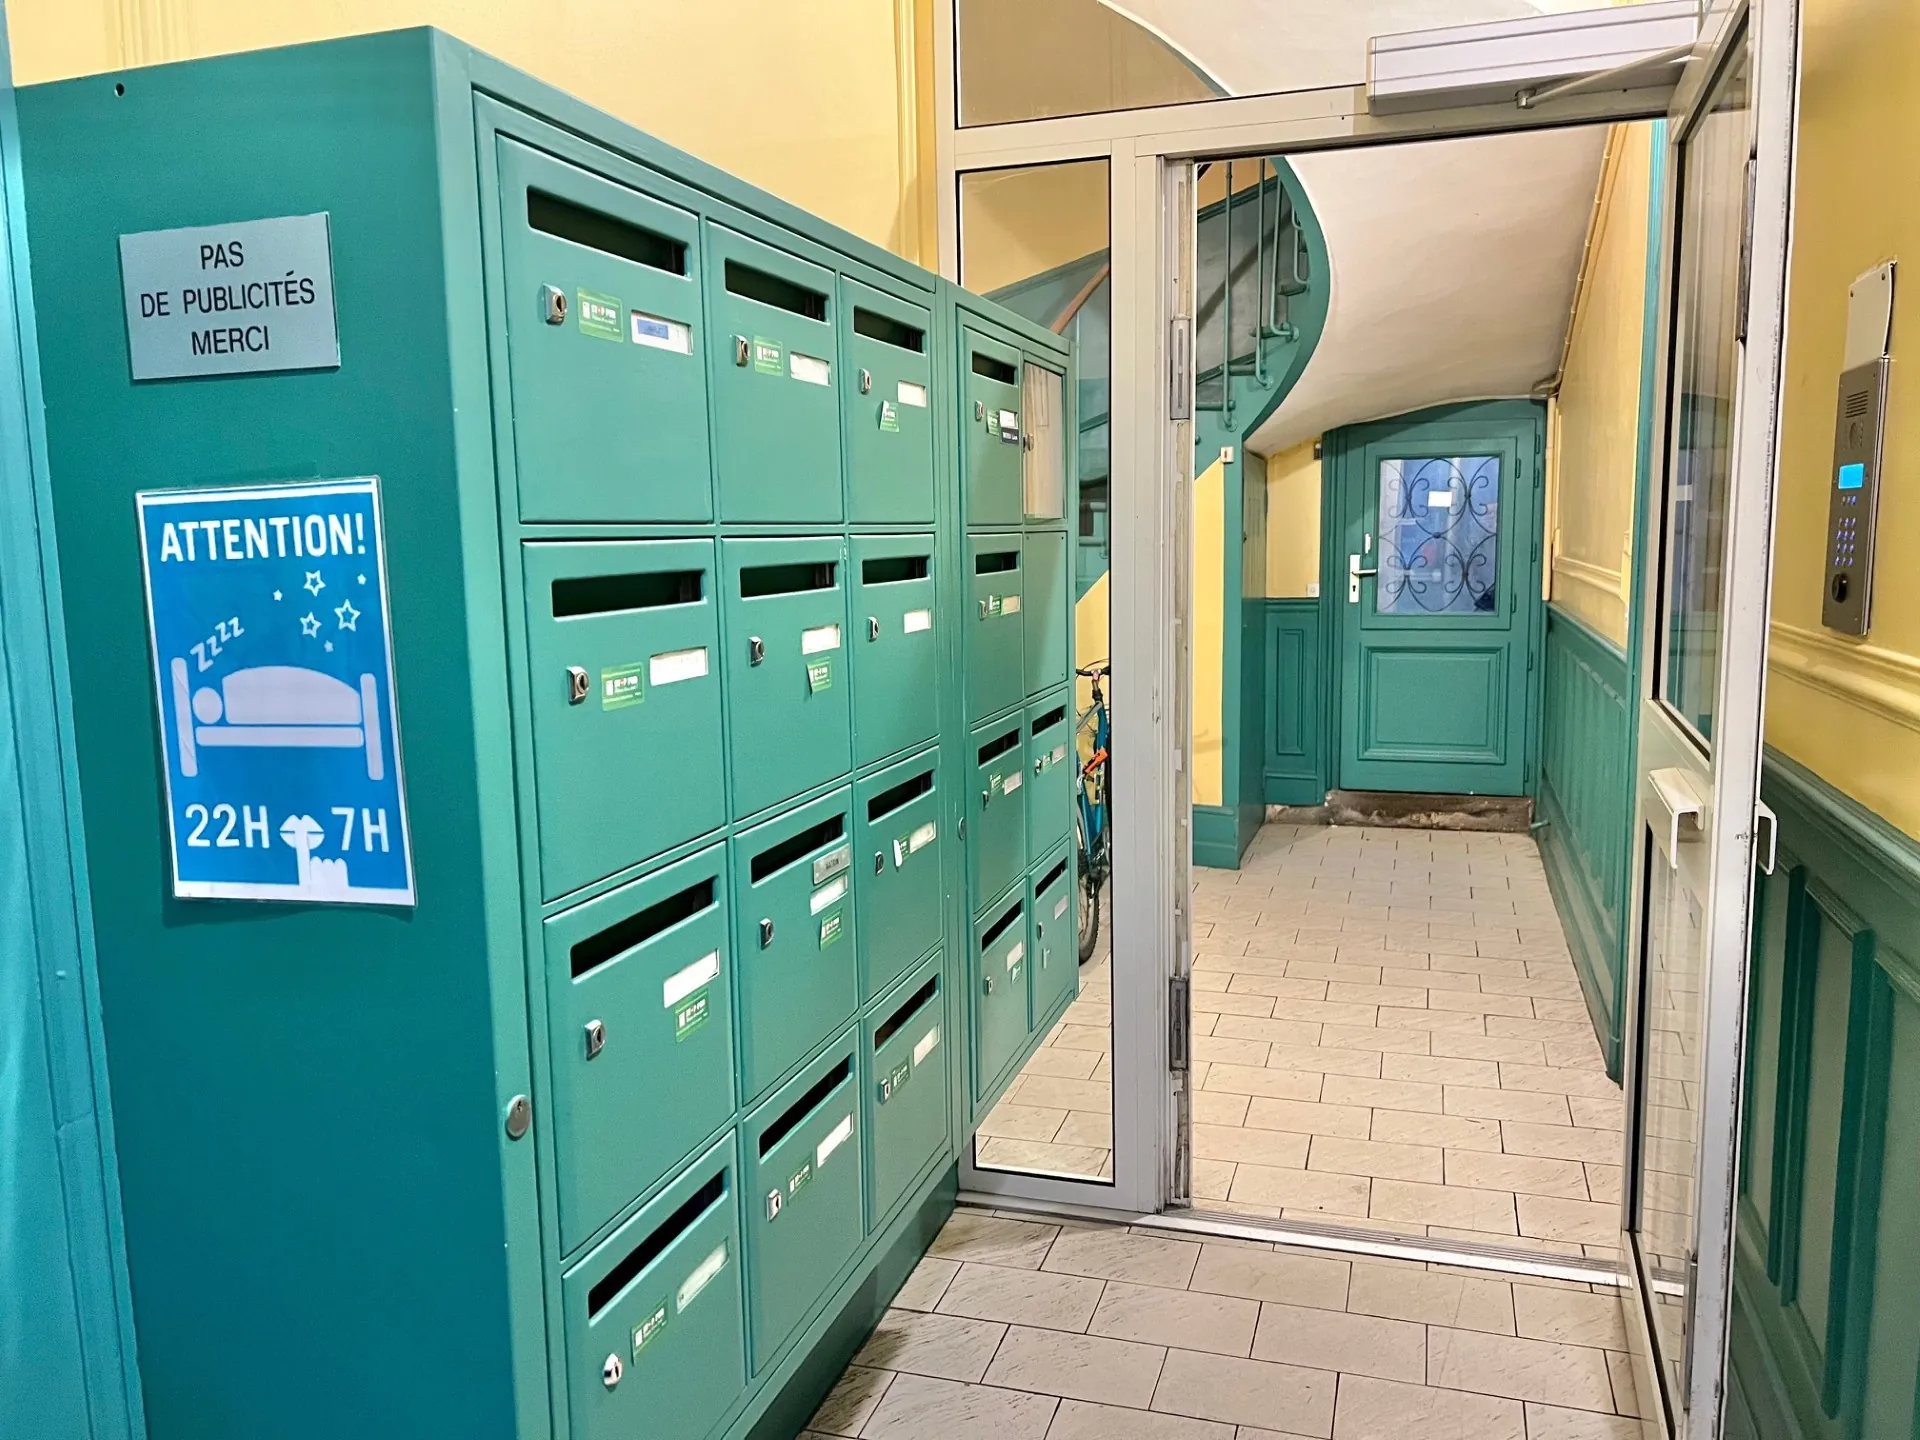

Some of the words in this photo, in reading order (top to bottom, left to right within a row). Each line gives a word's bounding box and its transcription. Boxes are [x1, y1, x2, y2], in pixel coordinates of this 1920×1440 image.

[200, 241, 244, 270] PAS
[140, 291, 170, 318] DE
[183, 270, 315, 314] PUBLICITÉS
[191, 325, 269, 356] MERCI
[160, 513, 366, 562] ATTENTION!
[185, 803, 270, 849] 22H
[331, 806, 390, 852] 7H
